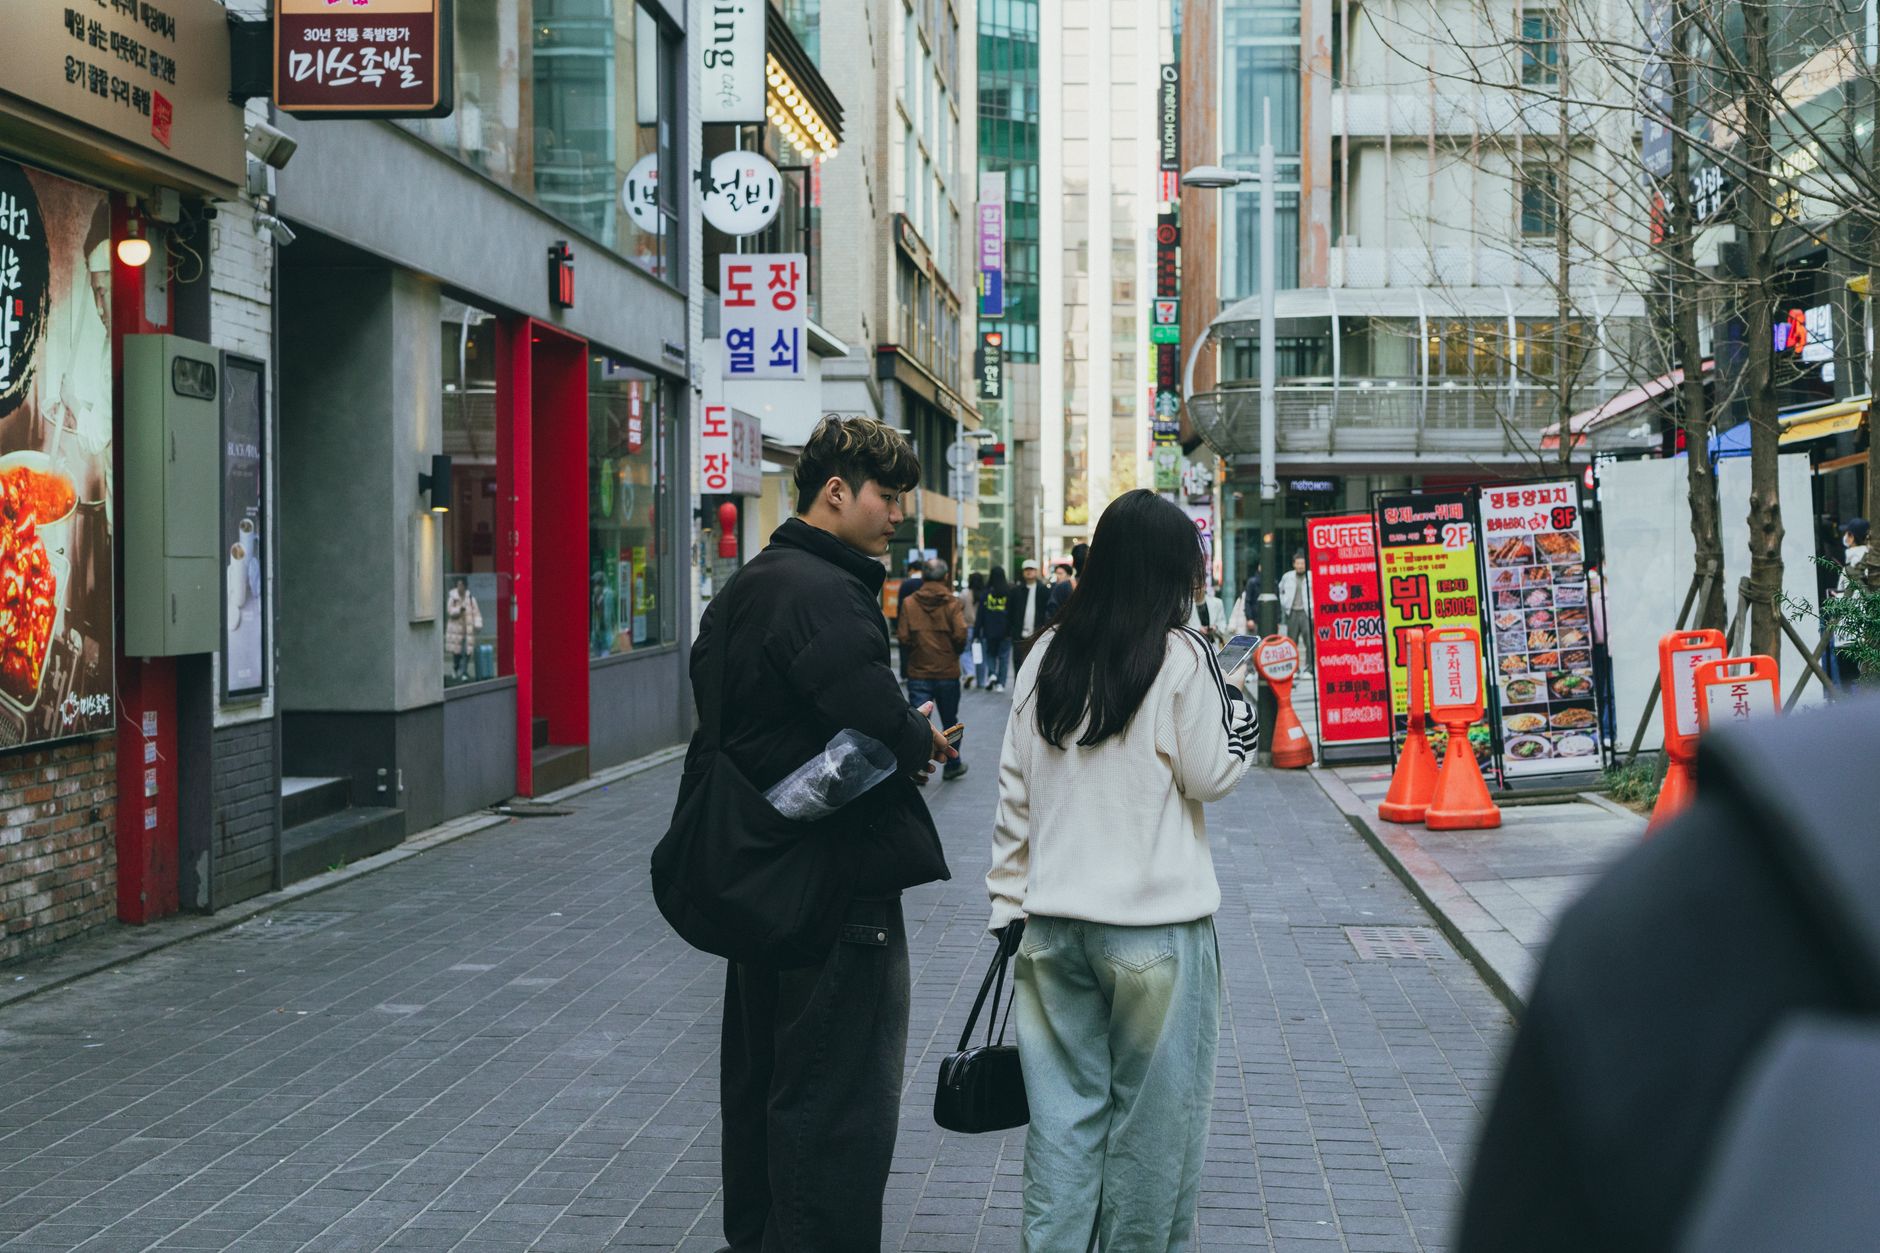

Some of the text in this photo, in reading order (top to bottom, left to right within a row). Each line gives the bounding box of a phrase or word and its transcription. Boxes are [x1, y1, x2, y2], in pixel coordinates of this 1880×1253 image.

[303, 28, 331, 43] 30년
[335, 28, 358, 43] 전통
[704, 0, 745, 69] ing
[288, 46, 424, 89] 미쓰족발
[111, 76, 130, 108] 우리
[132, 85, 151, 117] 족발
[723, 261, 801, 312] 도장
[726, 326, 799, 374] 열쇠
[702, 405, 730, 490] 도장
[1489, 487, 1568, 510] 명동양꼬치
[1551, 506, 1577, 530] 3F
[1443, 523, 1472, 550] 2F
[1445, 644, 1463, 700] 주차금지
[1730, 683, 1752, 719] 주차
